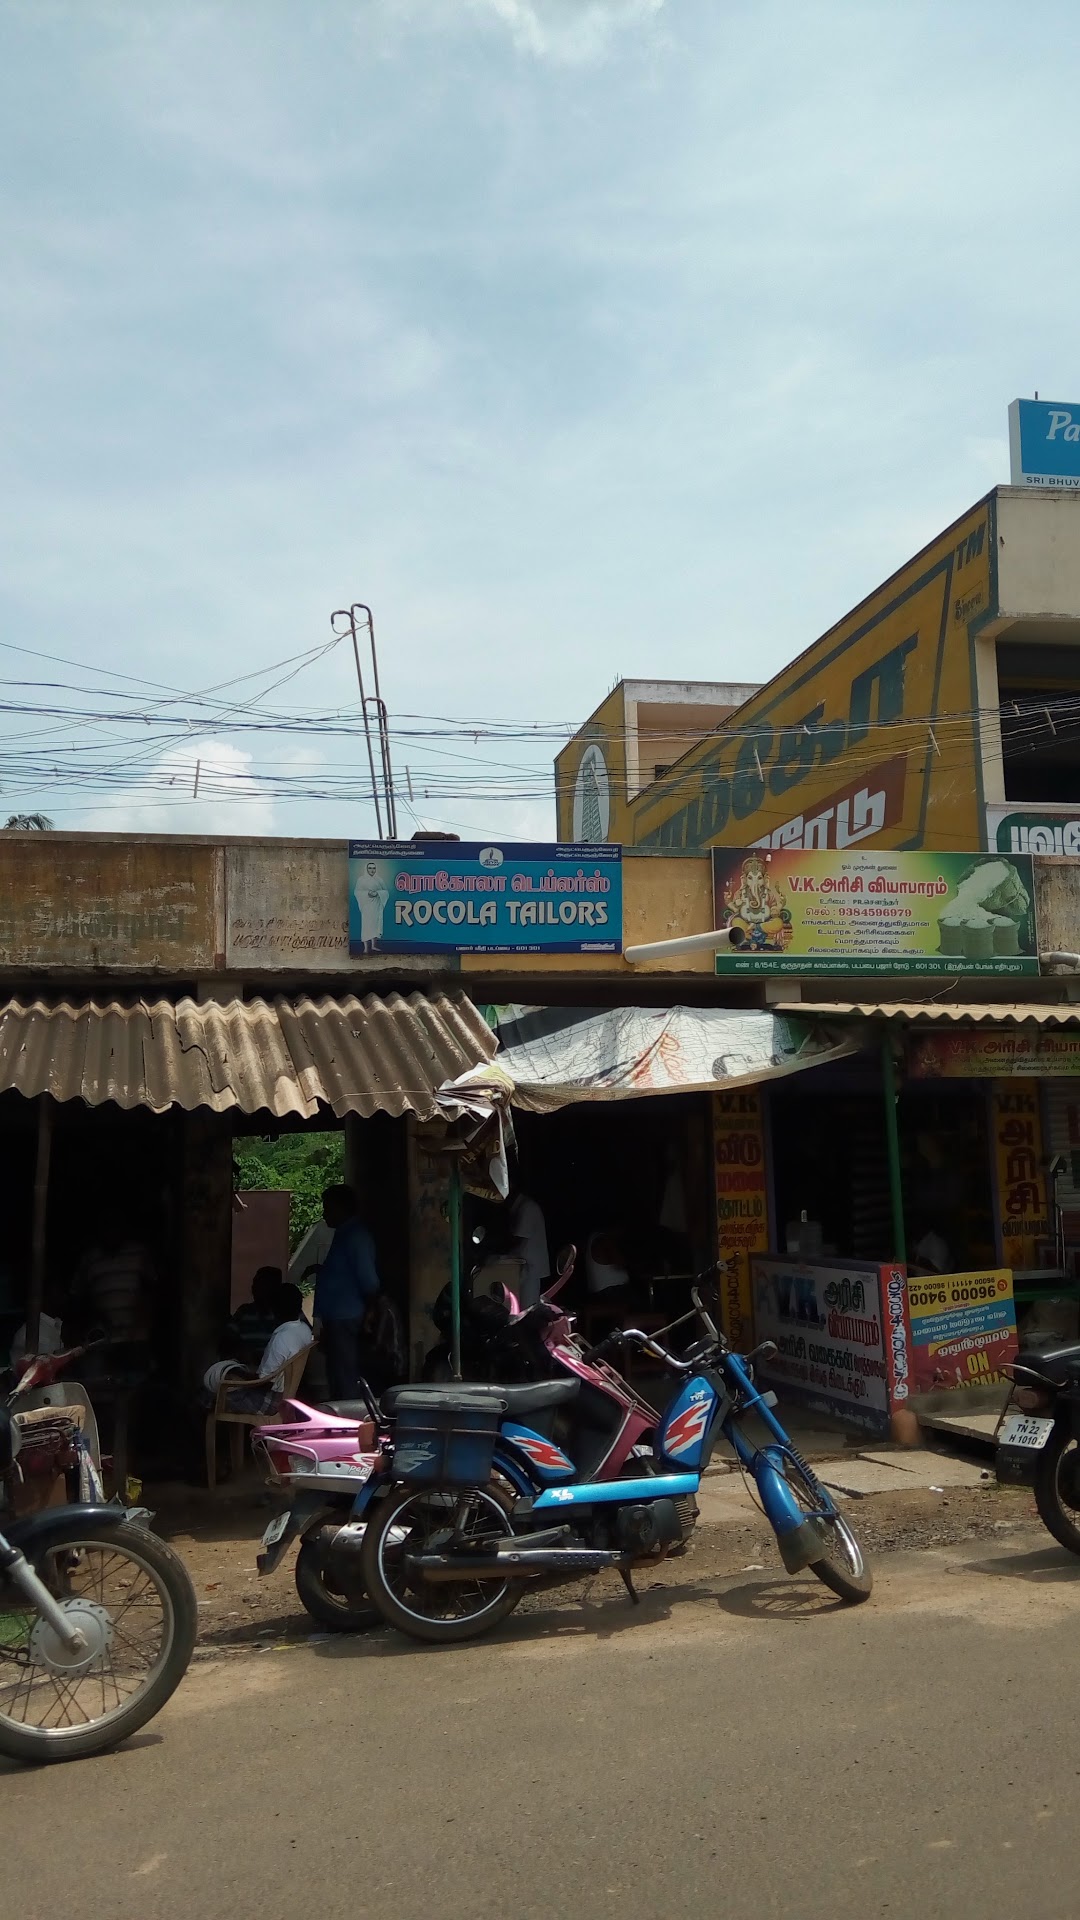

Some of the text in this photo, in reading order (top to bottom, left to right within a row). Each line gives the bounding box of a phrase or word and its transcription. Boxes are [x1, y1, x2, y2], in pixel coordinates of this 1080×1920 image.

[1046, 410, 1080, 441] Pa
[1026, 476, 1044, 484] SRI
[956, 521, 986, 571] TM
[788, 876, 949, 898] V.K.அரிசி வியாபாரம்
[395, 901, 609, 926] ROCOLA TAILORS
[806, 907, 830, 916] செல்
[838, 908, 912, 917] 9384596979
[951, 1285, 997, 1301] 96000
[966, 1350, 990, 1375] NO
[690, 1393, 704, 1401] TVS
[1017, 1424, 1041, 1435] TN 22
[1009, 1434, 1039, 1446] H 1010
[551, 1489, 573, 1498] XL
